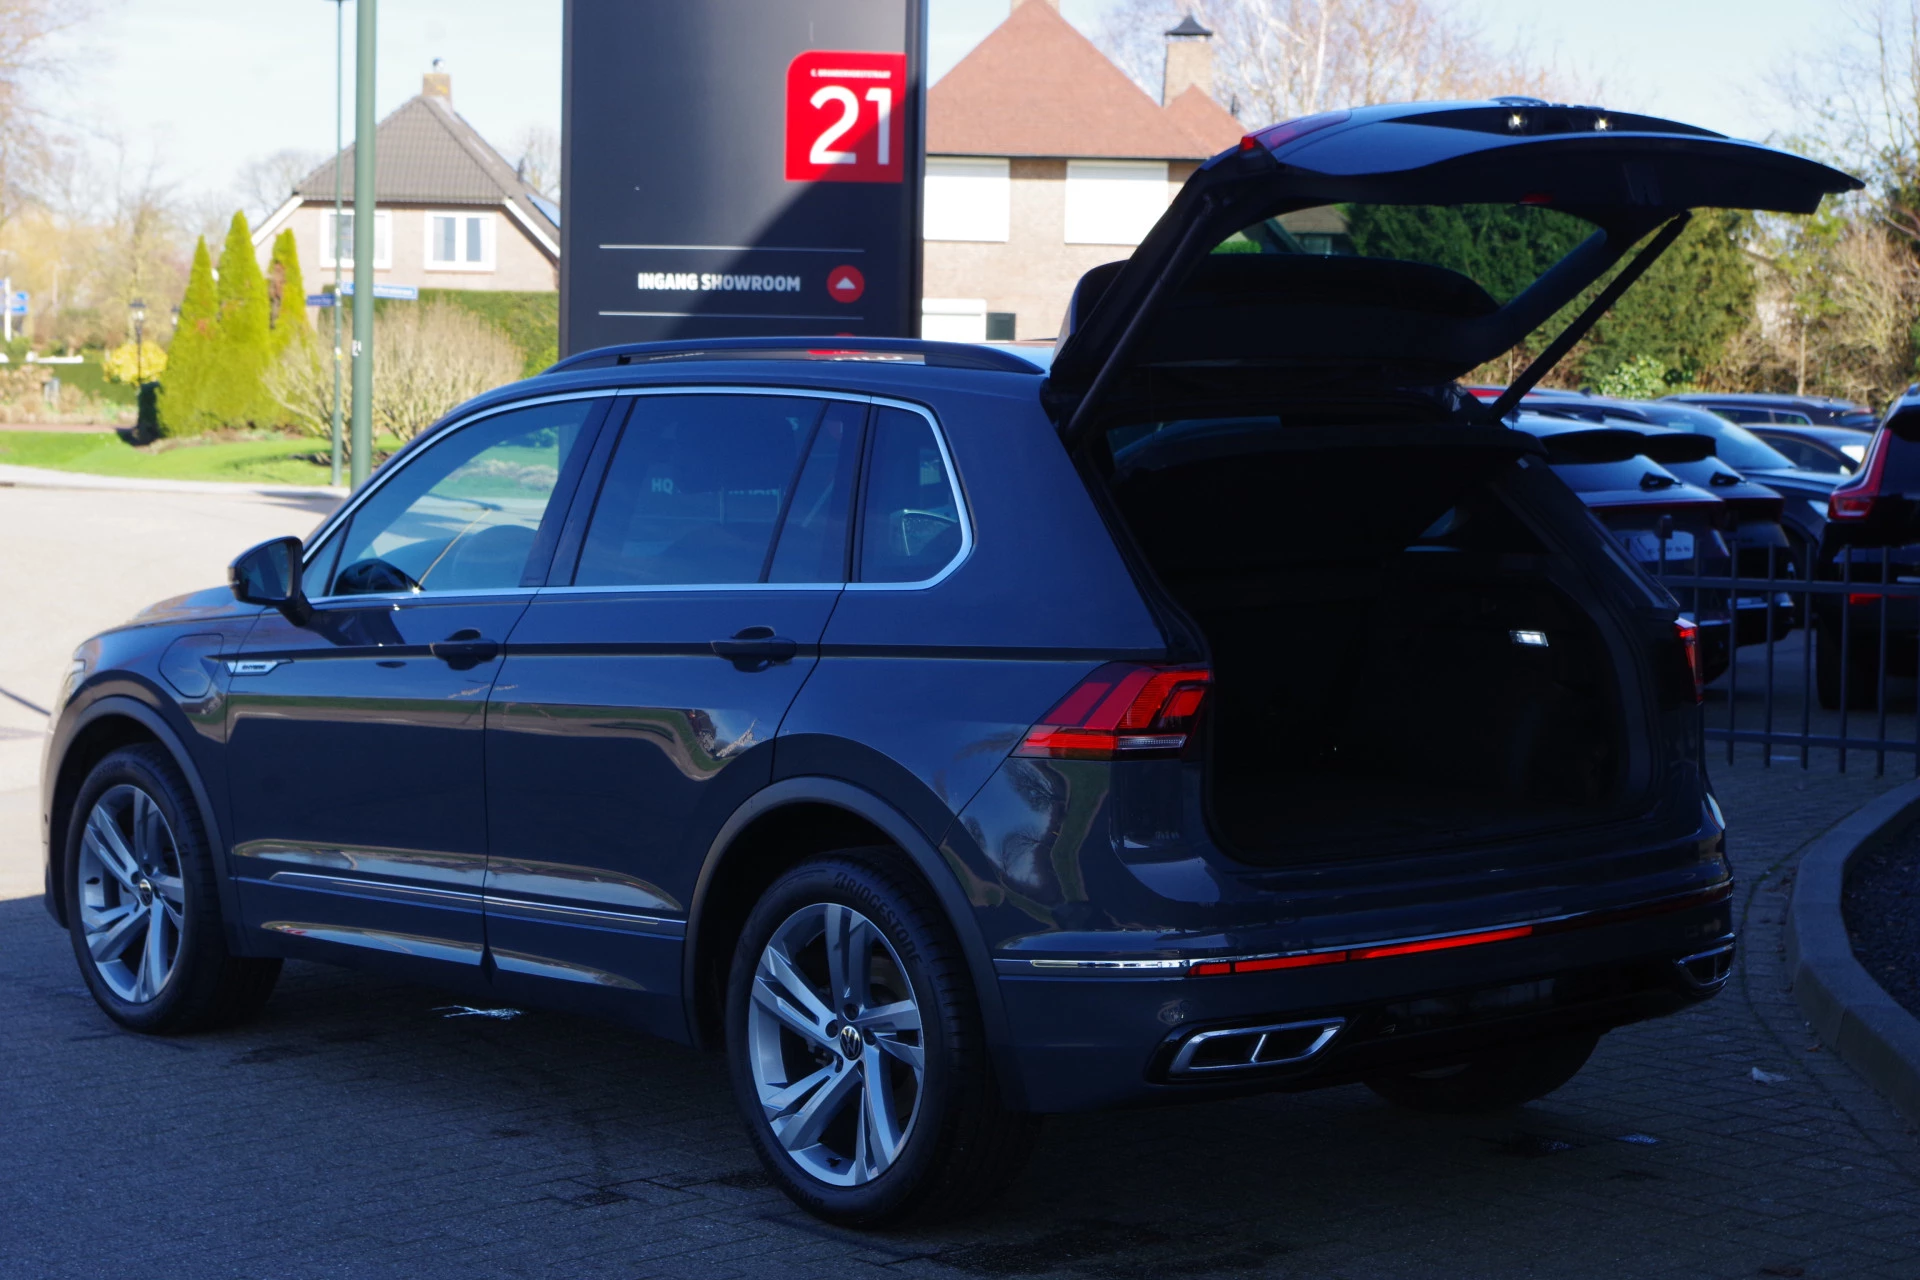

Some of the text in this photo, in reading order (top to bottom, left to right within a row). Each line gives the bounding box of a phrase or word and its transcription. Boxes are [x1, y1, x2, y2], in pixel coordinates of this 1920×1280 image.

[809, 85, 892, 165] 21
[637, 272, 801, 292] INGANG SHOWROOM
[651, 477, 674, 495] HQ
